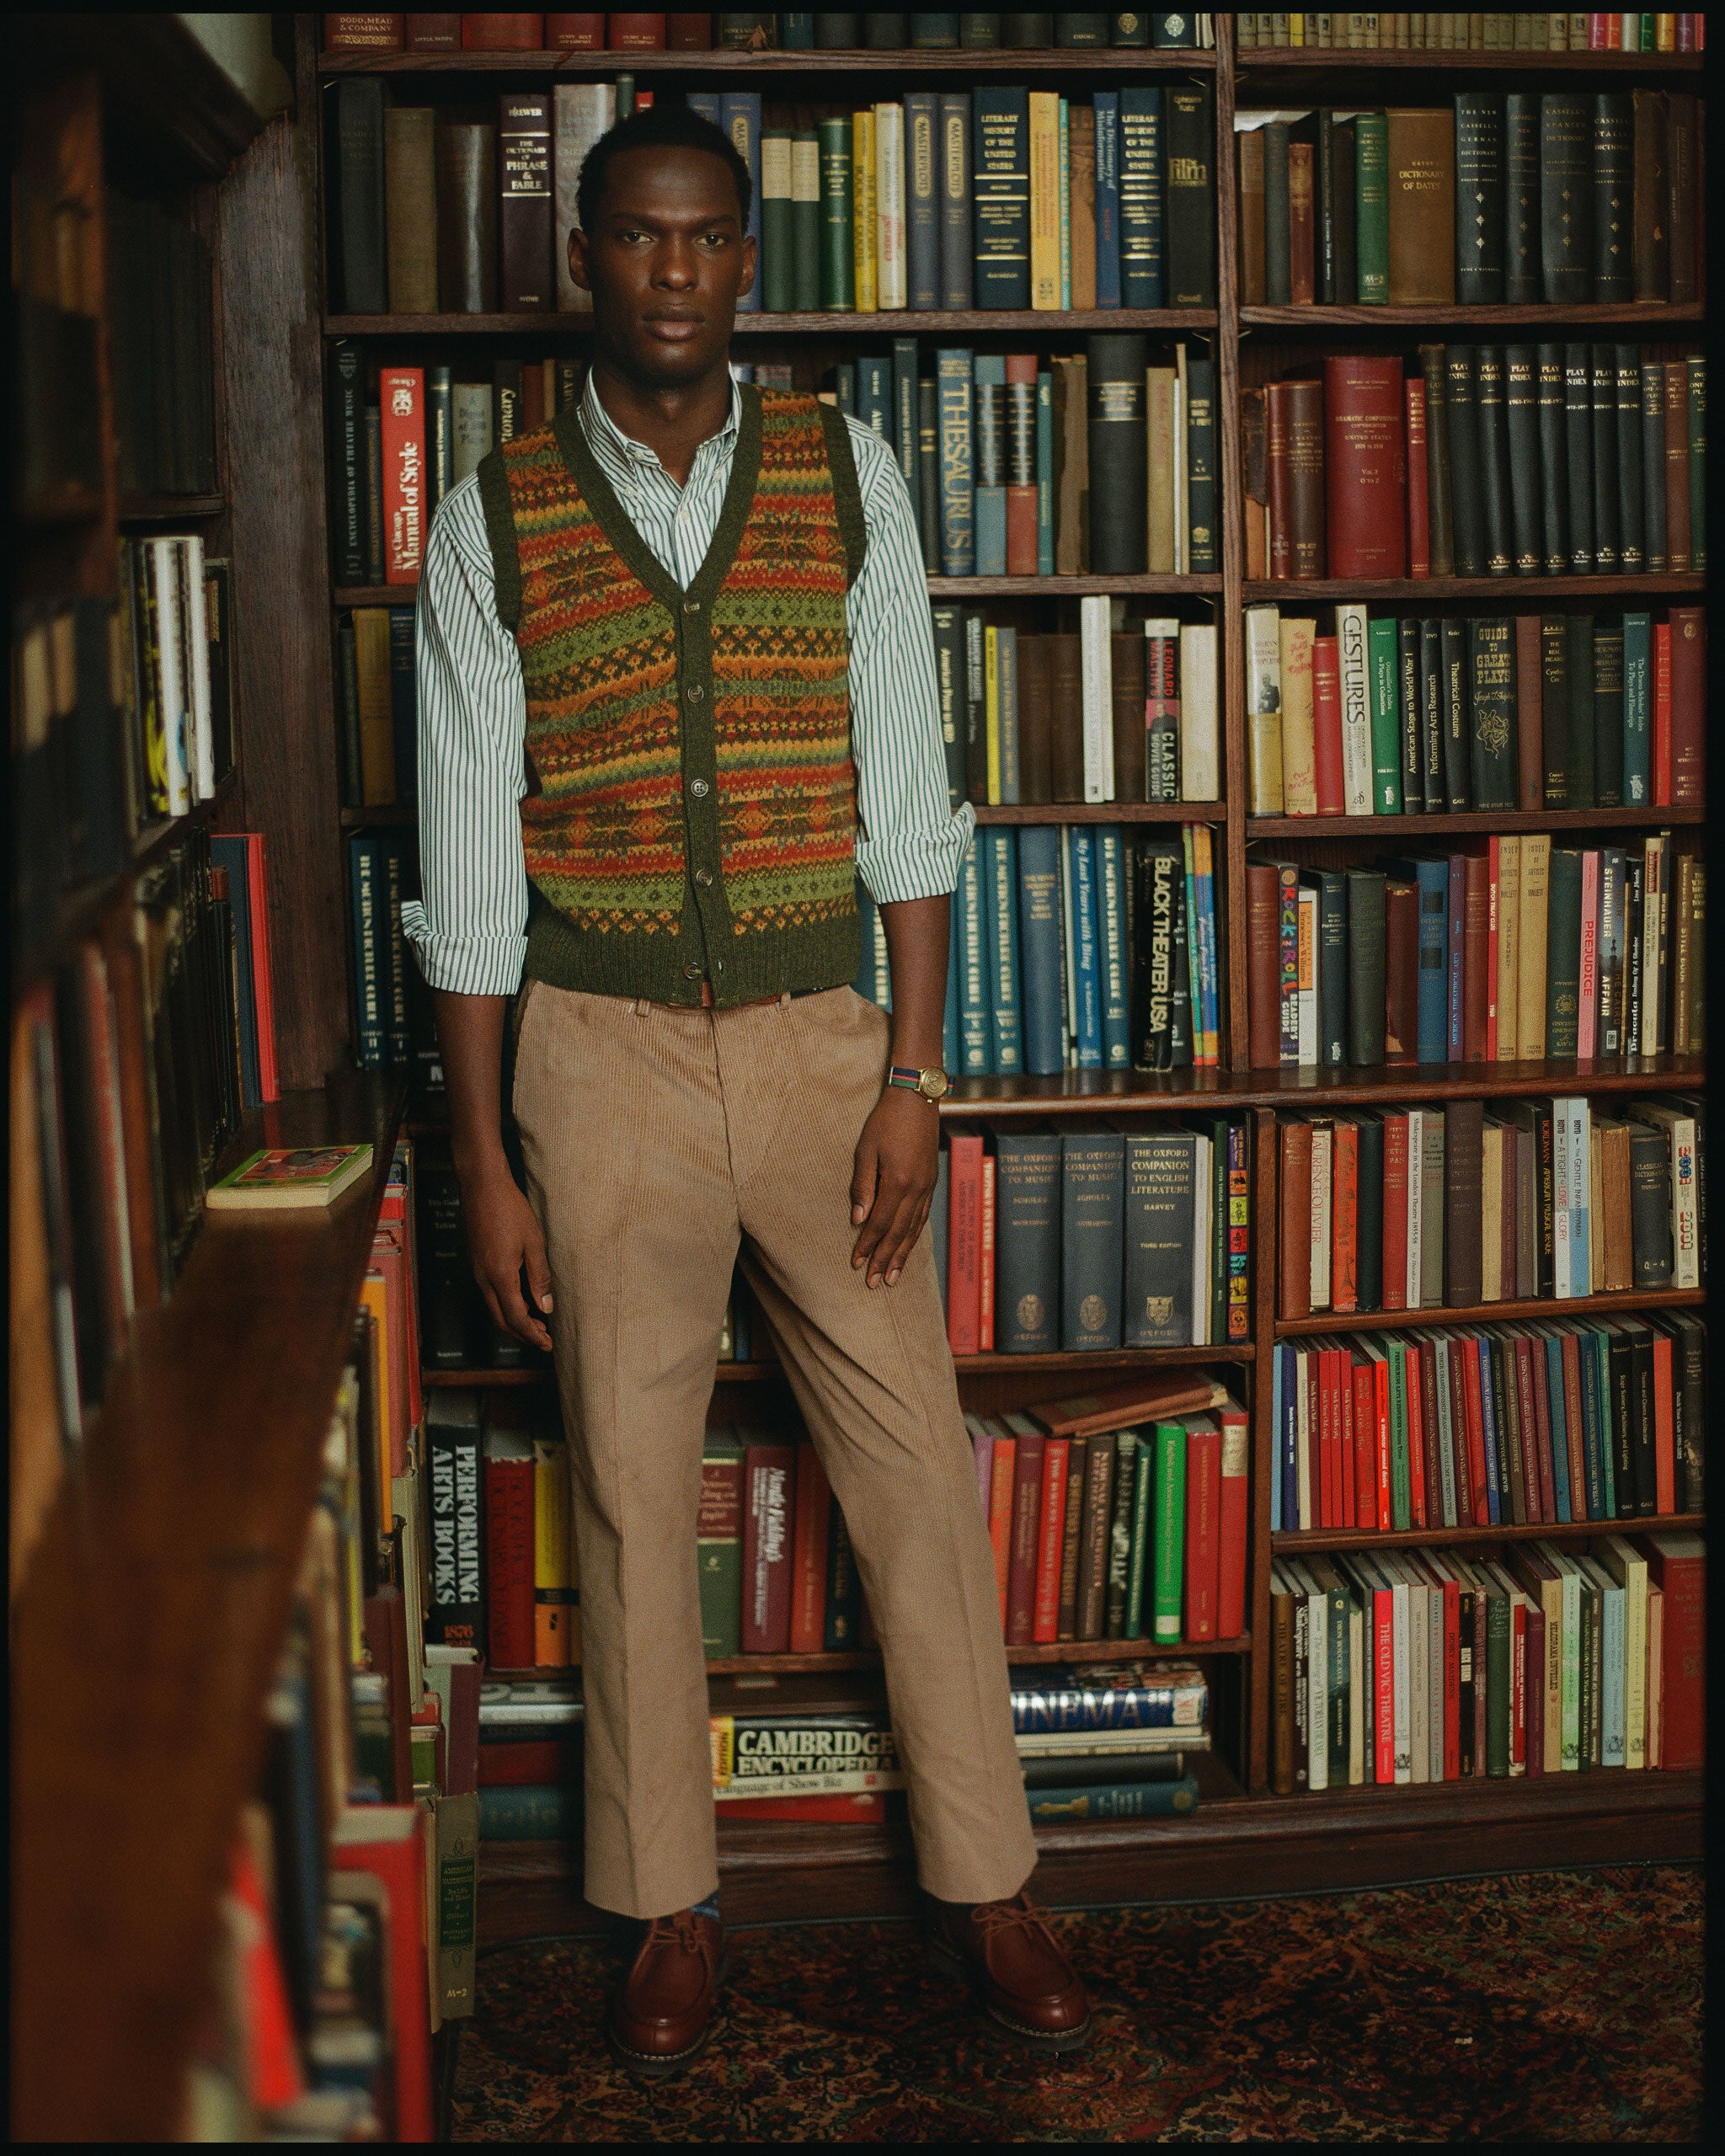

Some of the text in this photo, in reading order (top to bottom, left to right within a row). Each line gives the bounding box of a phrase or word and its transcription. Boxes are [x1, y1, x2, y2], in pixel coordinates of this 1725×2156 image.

[1105, 109, 1116, 126] The
[919, 122, 927, 191] MASTERPLOTS
[952, 123, 960, 193] MASTERPLOTS
[1096, 110, 1106, 183] Misinformation
[1105, 128, 1116, 177] Dictionary
[506, 161, 548, 171] PHRASE
[1399, 170, 1445, 179] DICTIONARY
[511, 180, 543, 189] FABLE
[1402, 181, 1441, 190] OF DATES
[1511, 365, 1530, 373] PLAY
[1540, 375, 1562, 383] INDEX
[1541, 365, 1560, 373] PLAY
[1619, 369, 1637, 377] PLAY
[345, 388, 358, 547] ENCYCLOPEDIA OF THEATRE MUSIC
[943, 383, 970, 549] THESAURUS
[398, 441, 421, 570] Manual of Style
[393, 511, 403, 569] The Chicago
[1478, 627, 1509, 640] GUIDE
[1488, 643, 1498, 652] TO
[1150, 641, 1161, 696] MALTIN'S
[1163, 641, 1174, 696] LEONARD
[1343, 615, 1365, 724] GESTURES
[1405, 658, 1413, 675] War
[1477, 654, 1511, 669] GREAT
[1477, 670, 1510, 684] PLAYS
[1628, 661, 1636, 670] To
[1658, 636, 1669, 702] SLEUTH
[1406, 676, 1414, 701] World
[1450, 662, 1461, 739] Theatrical Costume
[1407, 702, 1415, 711] to
[1407, 712, 1416, 733] Stage
[1428, 675, 1439, 775] Performing Arts Research
[1151, 734, 1160, 798] MOVIE GUIDE
[1162, 732, 1176, 798] CLASSIC
[1407, 734, 1416, 774] American
[1528, 845, 1545, 853] INDEX
[1076, 838, 1092, 970] My Last Years with Bing
[1604, 867, 1614, 938] STEINHAUER
[1149, 857, 1171, 1034] BLACK THEATER USA
[1281, 887, 1297, 995] ROCK ROLL
[1299, 911, 1308, 982] Tennessee Williams
[1583, 921, 1594, 997] PREJUDICE
[1601, 976, 1610, 1017] AFFAIR
[1282, 1001, 1290, 1033] GUIDE
[1290, 994, 1298, 1040] READER'S
[1133, 1149, 1189, 1158] THE OXFORD
[1541, 1118, 1550, 1163] BORDMAN
[1065, 1153, 1083, 1161] THE
[1065, 1162, 1121, 1171] COMPANION
[1131, 1161, 1190, 1171] COMPANION
[1557, 1155, 1566, 1178] FIGHT
[1071, 1173, 1085, 1182] TO
[1131, 1185, 1189, 1194] LITERATURE
[1133, 1173, 1189, 1182] TO ENGLISH
[1311, 1134, 1325, 1244] LAURENCE OLIVIER
[1558, 1186, 1567, 1206] LOVE
[1558, 1214, 1567, 1241] GLORY
[1621, 1449, 1630, 1470] Lighting
[432, 1445, 456, 1605] ARTS BOOKS
[456, 1444, 479, 1604] PERFORMING
[1278, 1621, 1288, 1718] THEATRE OF FIRE
[1550, 1621, 1558, 1690] MELODRAMA UNVEILED
[1380, 1621, 1391, 1743] THE OLD VIC THEATRE
[738, 1730, 894, 1756] CAMBRIDGE
[738, 1756, 894, 1775] ENCYCLOPEDIA
